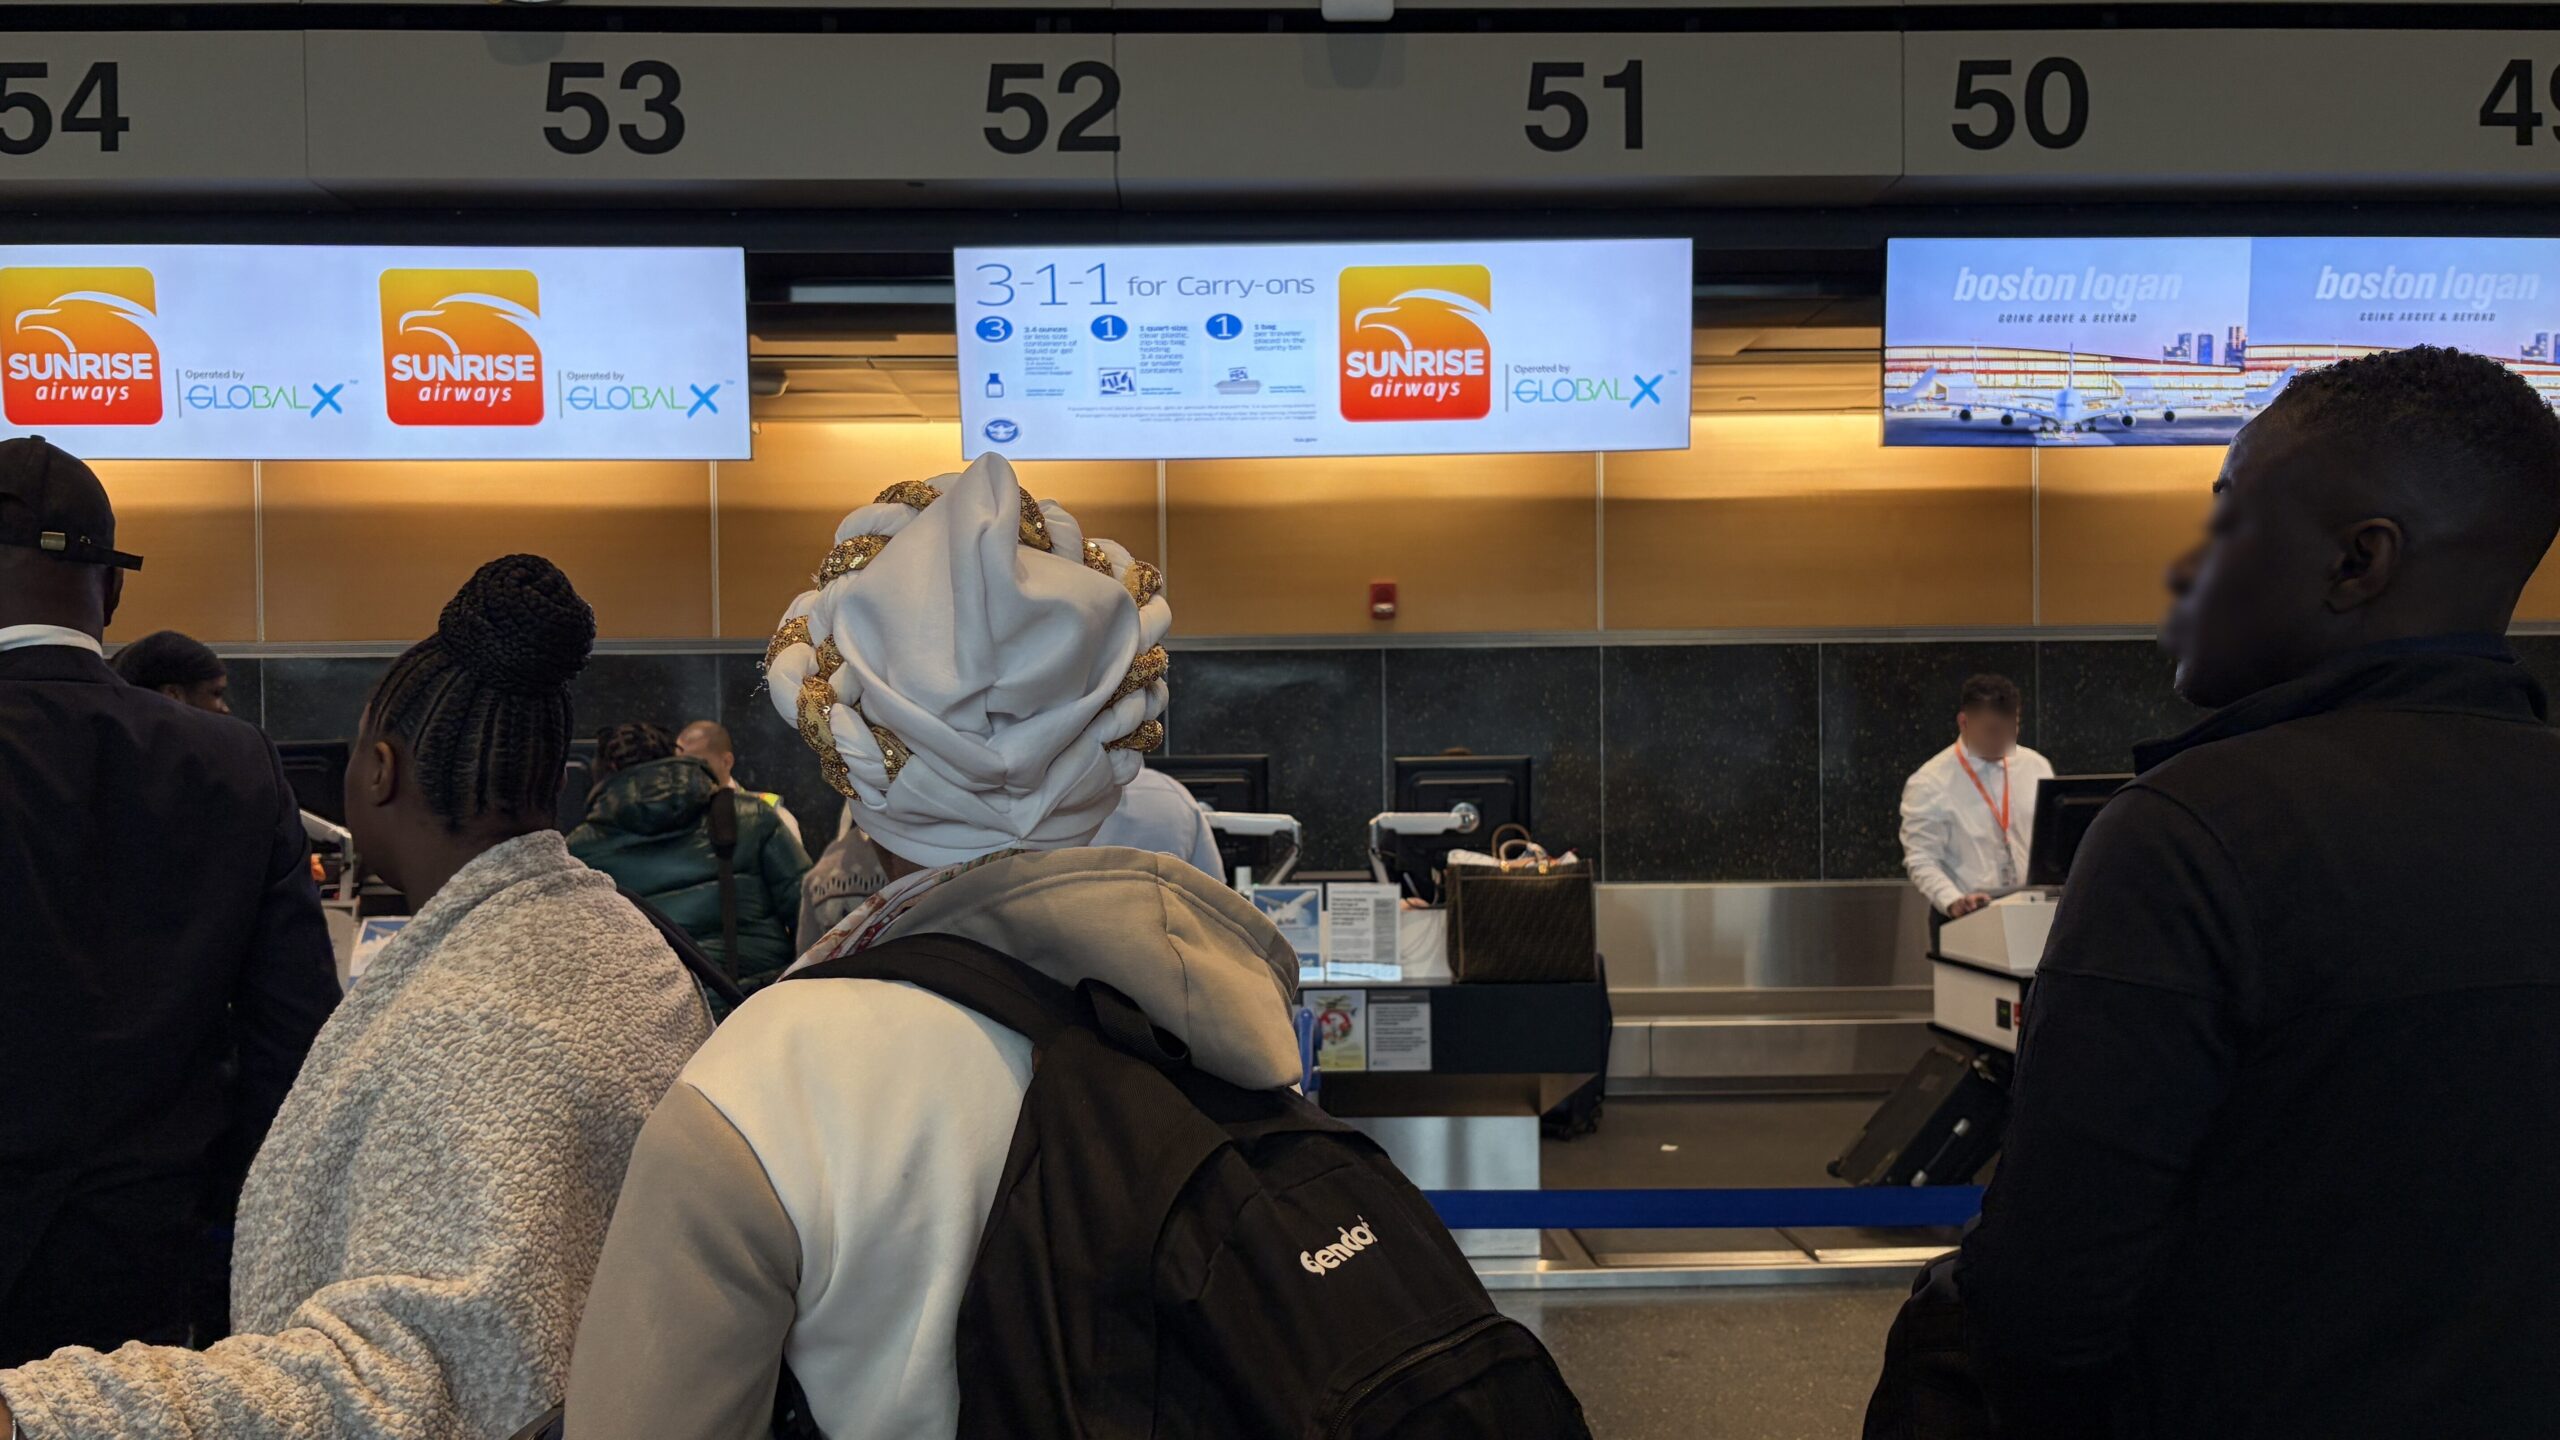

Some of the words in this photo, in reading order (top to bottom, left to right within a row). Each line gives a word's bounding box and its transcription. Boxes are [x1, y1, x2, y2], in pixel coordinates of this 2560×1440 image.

[0, 61, 130, 156] 54
[541, 59, 687, 156] 53
[982, 60, 1122, 155] 52
[1524, 59, 1644, 153] 51
[1950, 56, 2090, 151] 50
[2479, 59, 2560, 146] 4
[976, 262, 1118, 307] 3-1-1
[1127, 275, 1167, 297] for
[1177, 276, 1316, 298] Carry-ons
[1953, 266, 2077, 301] boston
[2080, 266, 2184, 312] logan
[2315, 265, 2437, 300] boston
[2440, 265, 2542, 311] logan
[984, 319, 1006, 340] 3
[1100, 316, 1118, 339] 1
[1215, 315, 1233, 337] 1
[1998, 313, 2034, 323] GOING
[2038, 313, 2075, 323] ABOVE
[2092, 313, 2138, 323] BEYOND
[2359, 312, 2395, 322] GOING
[2398, 312, 2435, 322] ABOVE
[2452, 312, 2496, 322] BEYOND
[8, 352, 153, 381] SUNRISE
[185, 370, 230, 380] Operated
[231, 370, 245, 382] by
[391, 353, 536, 382] SUNRISE
[566, 371, 610, 381] Operated
[612, 371, 625, 382] by
[1346, 349, 1485, 378] SUNRISE
[1514, 364, 1556, 374] Operated
[1558, 364, 1570, 375] by
[35, 382, 130, 407] airways
[418, 383, 512, 407] airways
[1369, 378, 1461, 403] airways
